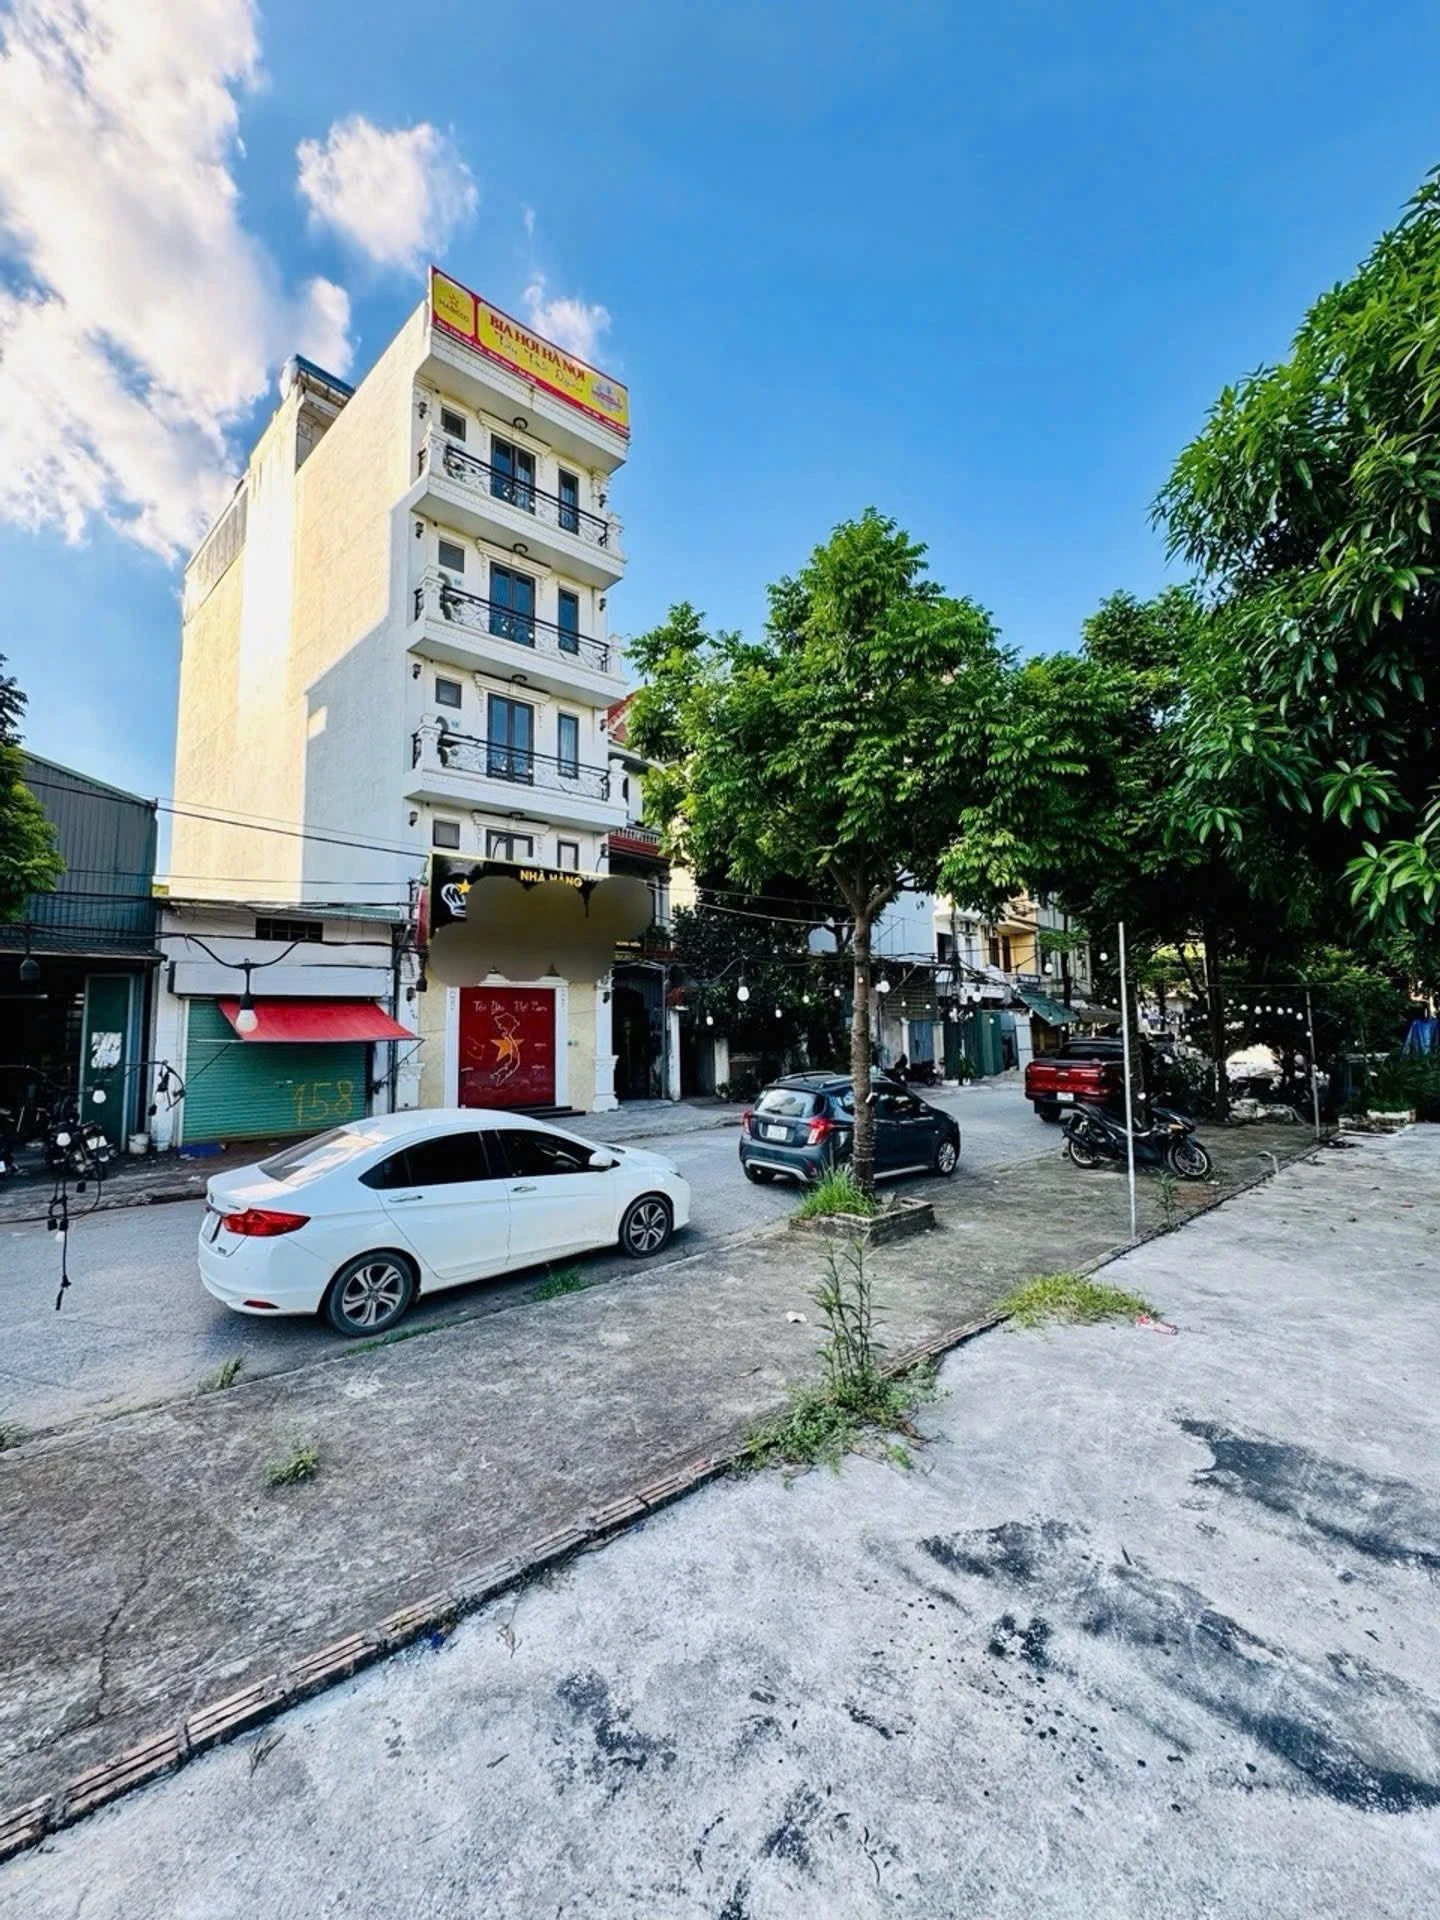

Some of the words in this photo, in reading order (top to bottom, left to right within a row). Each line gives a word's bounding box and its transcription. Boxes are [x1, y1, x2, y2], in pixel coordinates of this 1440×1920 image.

[489, 313, 513, 338] BIA
[520, 869, 545, 883] NHÀ
[293, 1079, 354, 1126] 158
